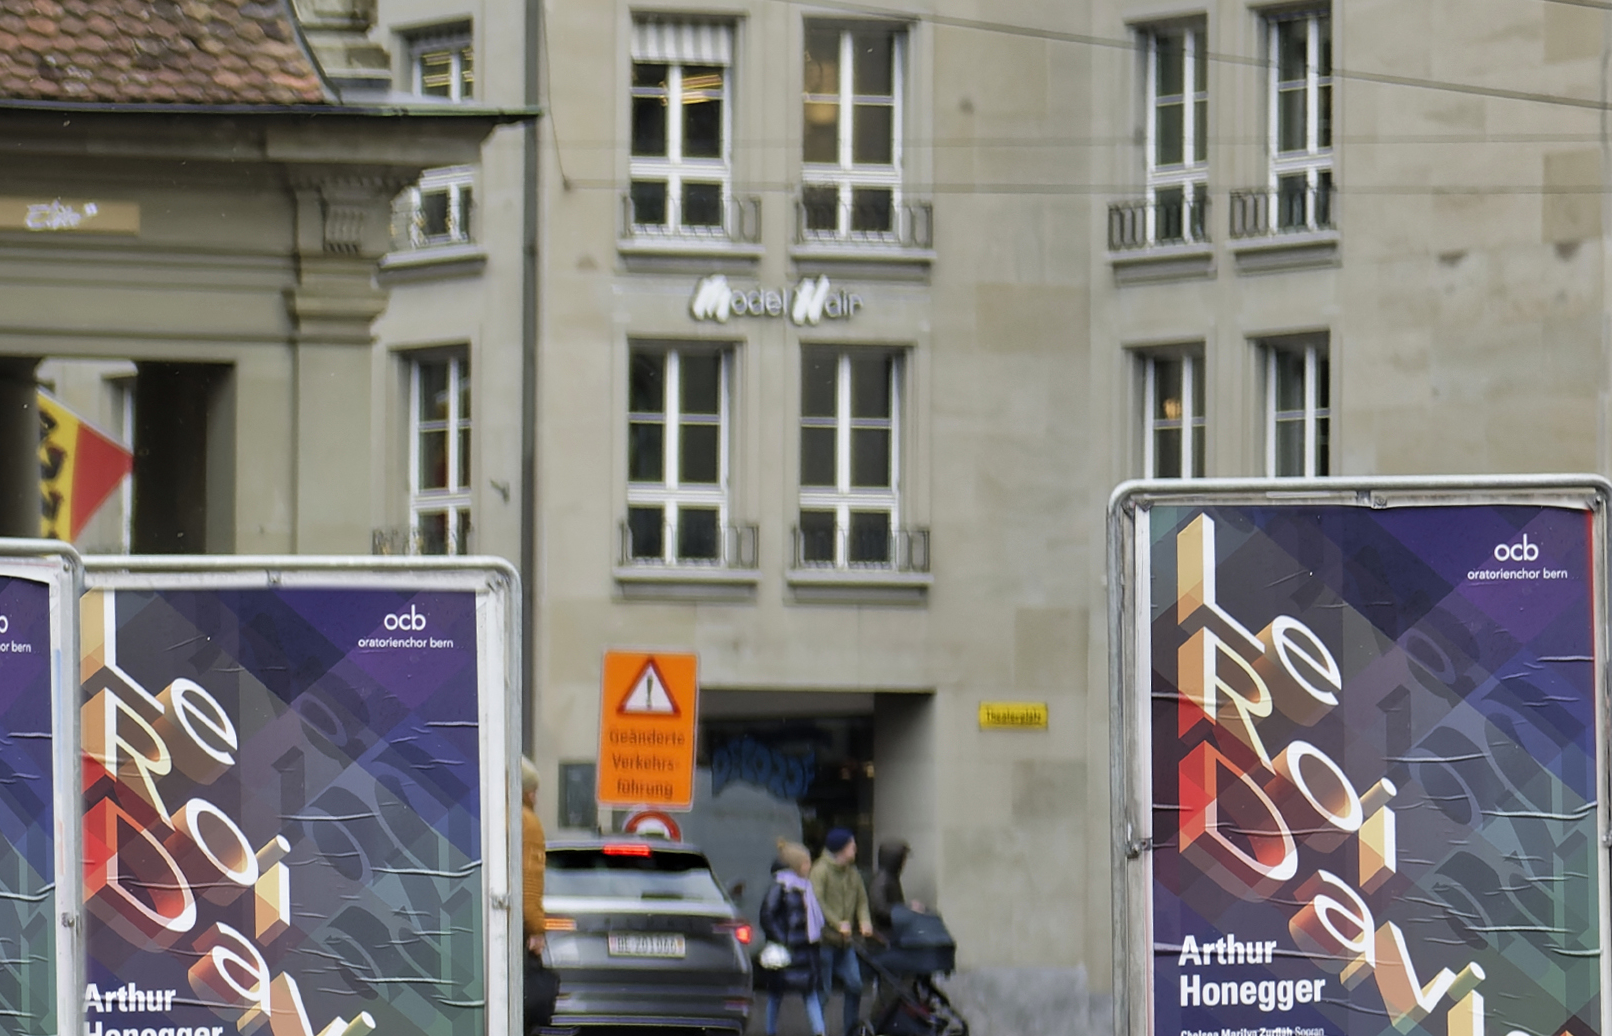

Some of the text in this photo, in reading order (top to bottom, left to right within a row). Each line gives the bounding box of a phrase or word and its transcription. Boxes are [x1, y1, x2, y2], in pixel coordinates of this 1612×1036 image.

[1493, 533, 1539, 562] ocb
[1467, 567, 1568, 580] oratorienchor bern
[383, 603, 426, 631] ocb
[11, 640, 32, 653] bern
[357, 636, 454, 648] oratorienchor bern
[1178, 933, 1277, 966] Arthur
[83, 981, 176, 1013] Arthur
[1179, 974, 1326, 1012] Honegger
